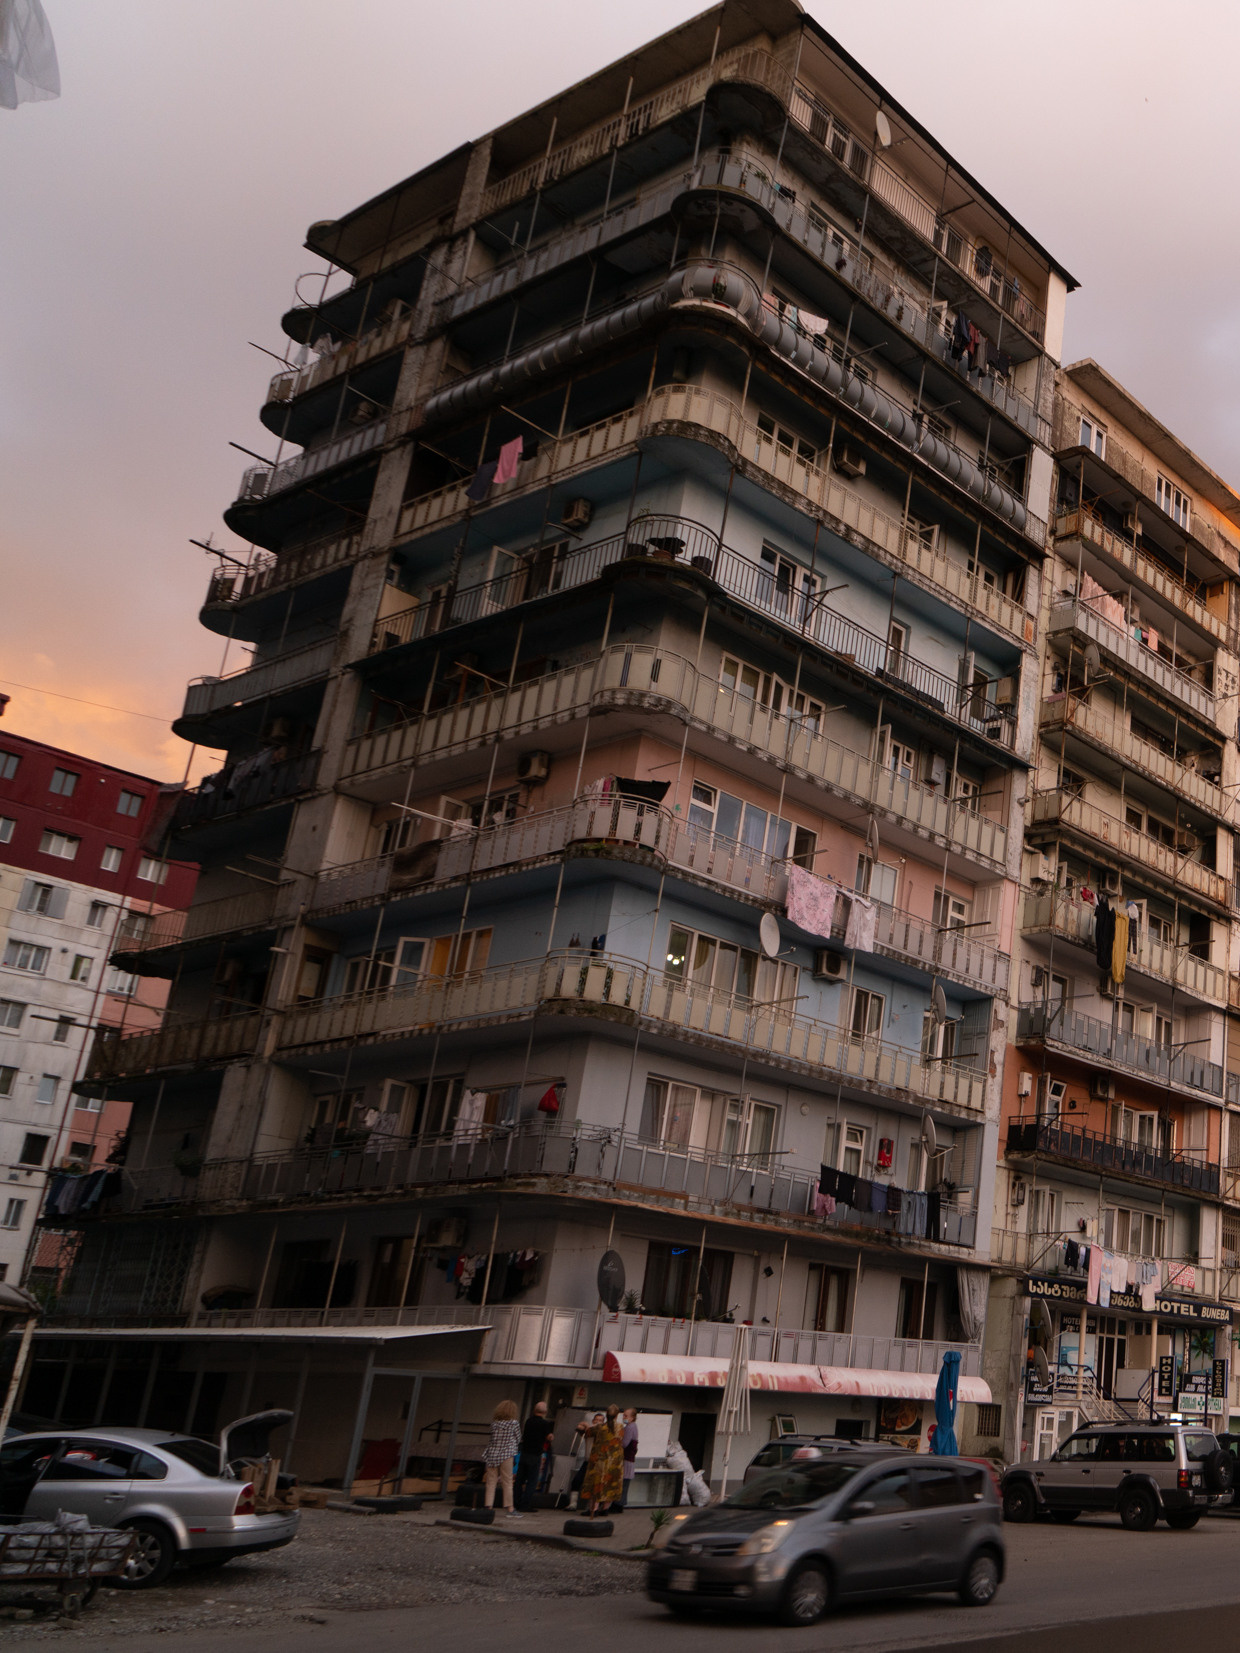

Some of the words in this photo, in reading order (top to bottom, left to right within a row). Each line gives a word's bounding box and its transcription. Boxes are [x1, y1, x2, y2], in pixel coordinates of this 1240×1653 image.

[1028, 1279, 1088, 1301] სასტუმრ
[1110, 1293, 1142, 1308] უნება
[1201, 1306, 1230, 1321] BUNEBA
[1161, 1358, 1172, 1395] HOTEL
